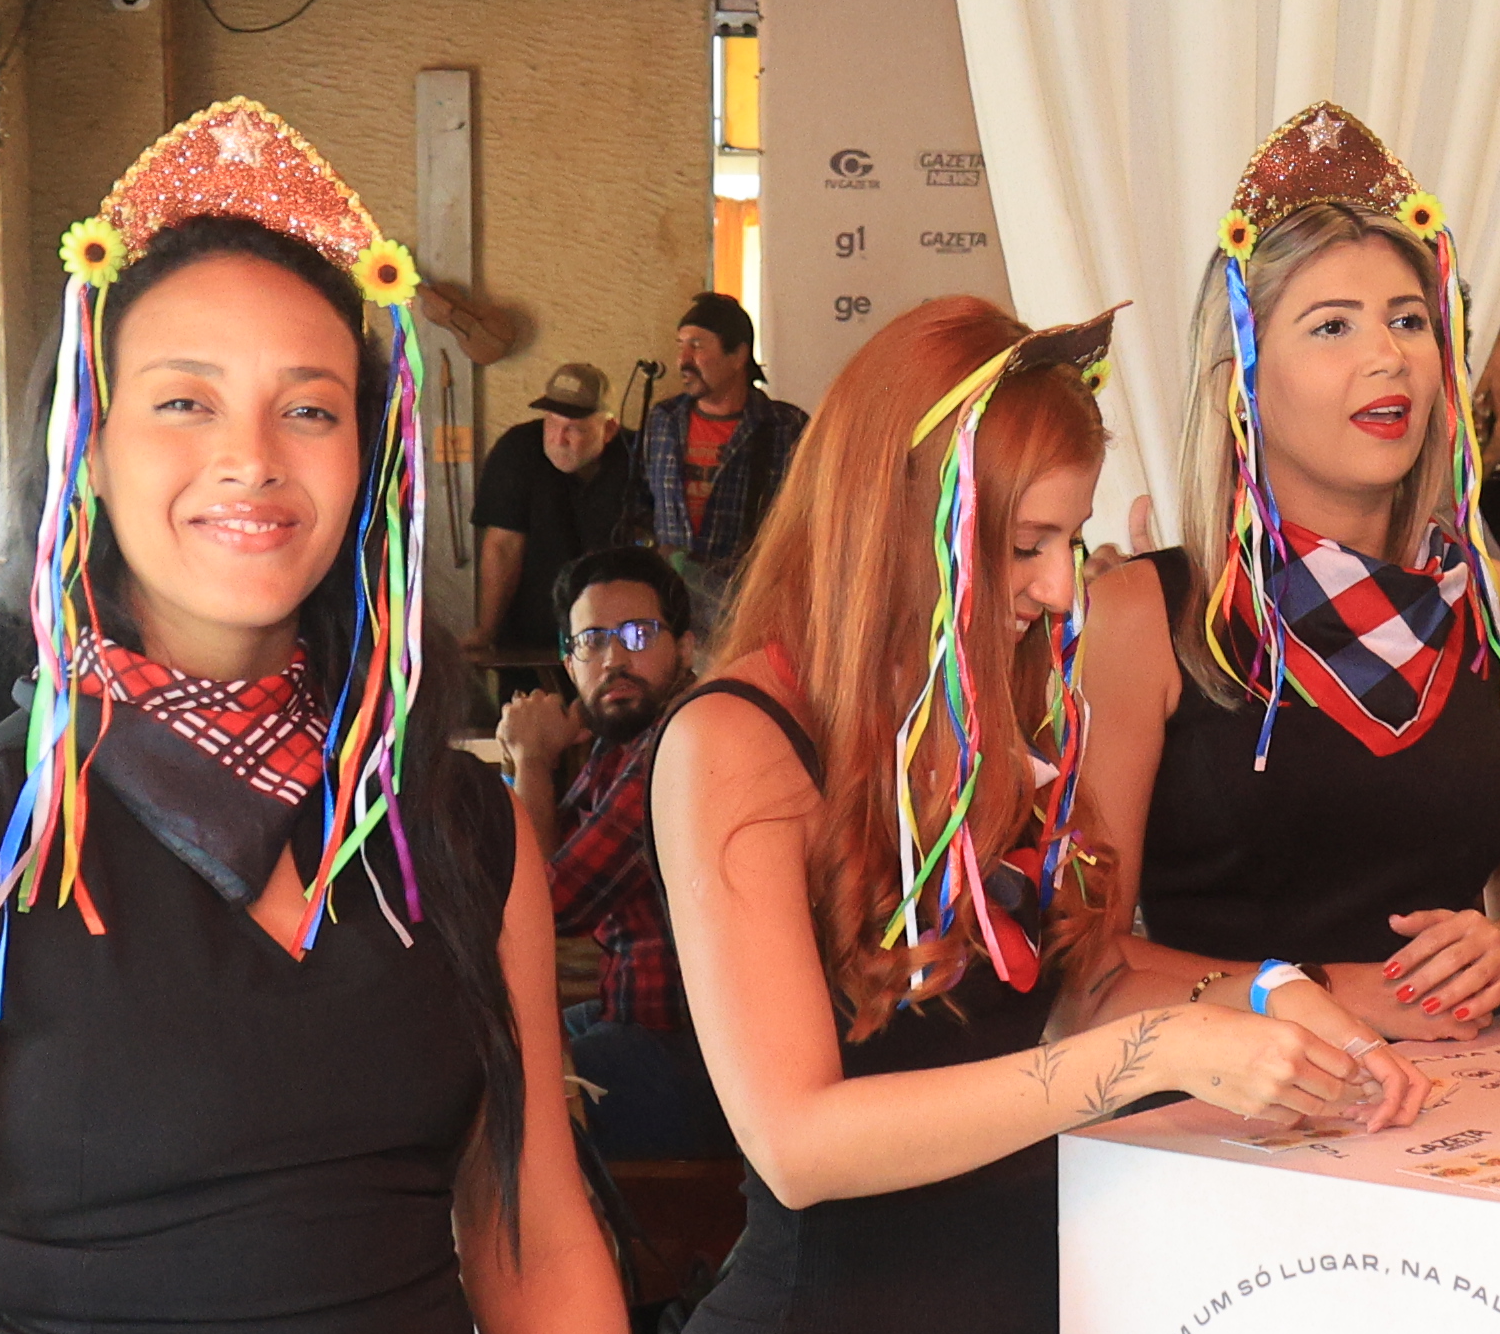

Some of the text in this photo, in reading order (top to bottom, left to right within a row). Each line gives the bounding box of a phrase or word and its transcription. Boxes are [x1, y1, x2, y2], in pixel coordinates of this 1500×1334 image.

[835, 225, 866, 258] g1
[920, 231, 987, 248] GAZETA
[834, 295, 871, 322] ge
[1193, 1290, 1233, 1327] UM
[1237, 1265, 1272, 1296] SÓ
[1280, 1253, 1390, 1280] LUGAR,
[1401, 1258, 1441, 1286] NA
